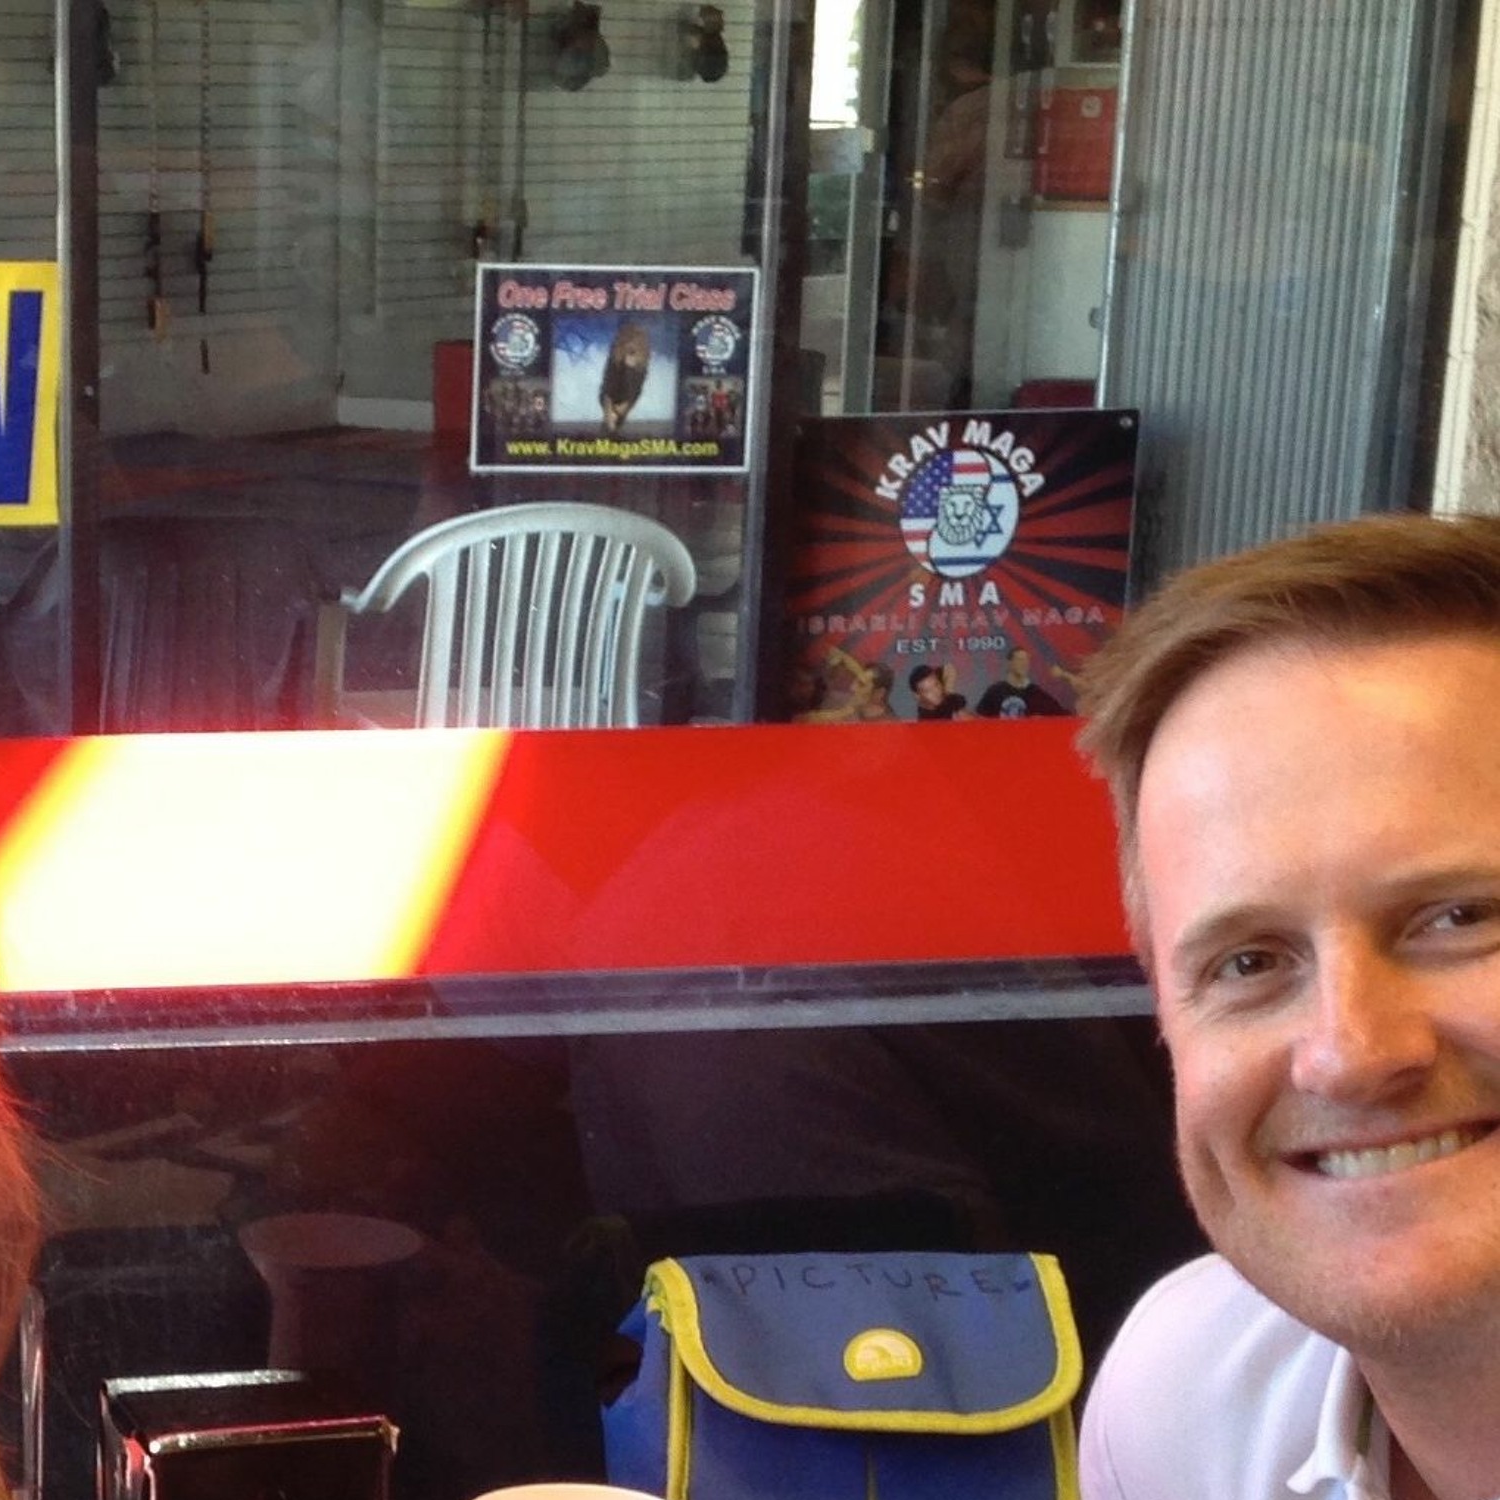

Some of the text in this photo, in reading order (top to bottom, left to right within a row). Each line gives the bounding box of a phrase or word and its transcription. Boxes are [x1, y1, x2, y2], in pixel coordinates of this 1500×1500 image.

[497, 280, 548, 309] One
[551, 280, 608, 310] Free
[613, 281, 667, 311] Trial
[505, 438, 720, 460] www. KravMagaSMA.com
[875, 419, 1046, 501] KRAV MAGA
[1022, 605, 1105, 627] MAGA
[896, 638, 938, 654] EST
